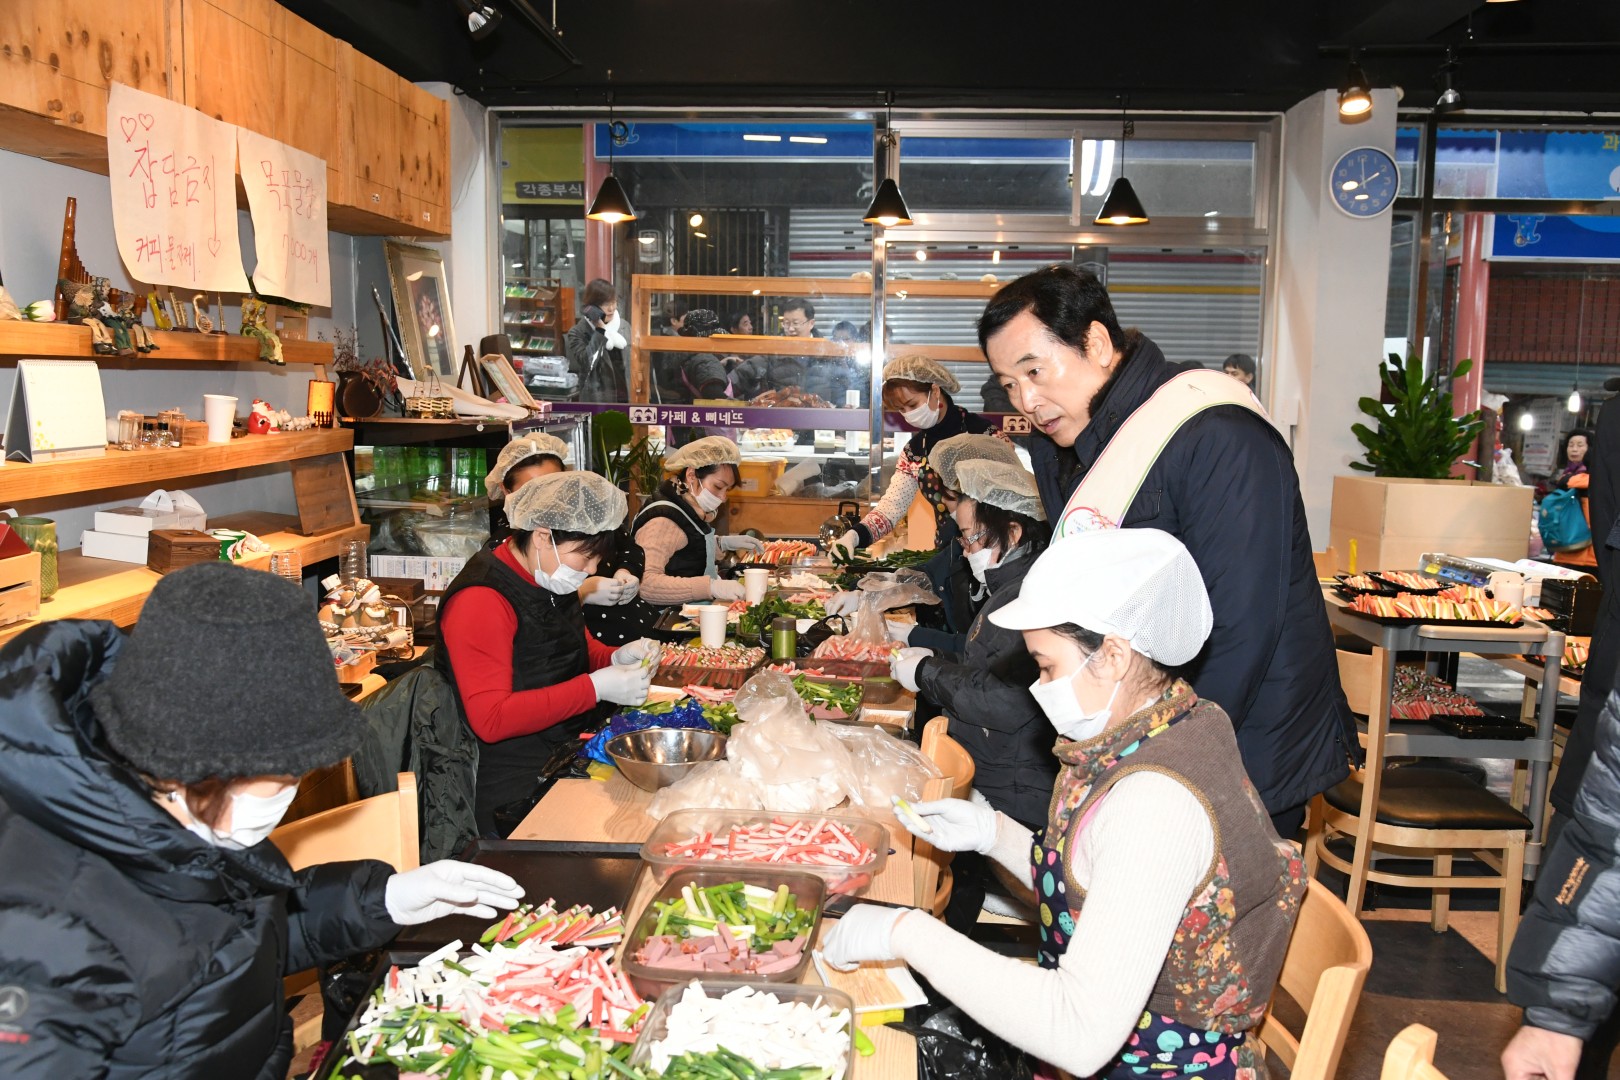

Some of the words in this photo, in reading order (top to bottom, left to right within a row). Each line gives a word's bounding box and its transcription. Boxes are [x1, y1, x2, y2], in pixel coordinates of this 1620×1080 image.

[1380, 164, 1387, 173] 2
[129, 140, 217, 240] 잡담금지
[260, 160, 317, 219] 목표물량
[522, 183, 582, 197] 각종부식
[282, 233, 319, 284] 7000개
[661, 411, 686, 424] 카페
[691, 412, 701, 423] &
